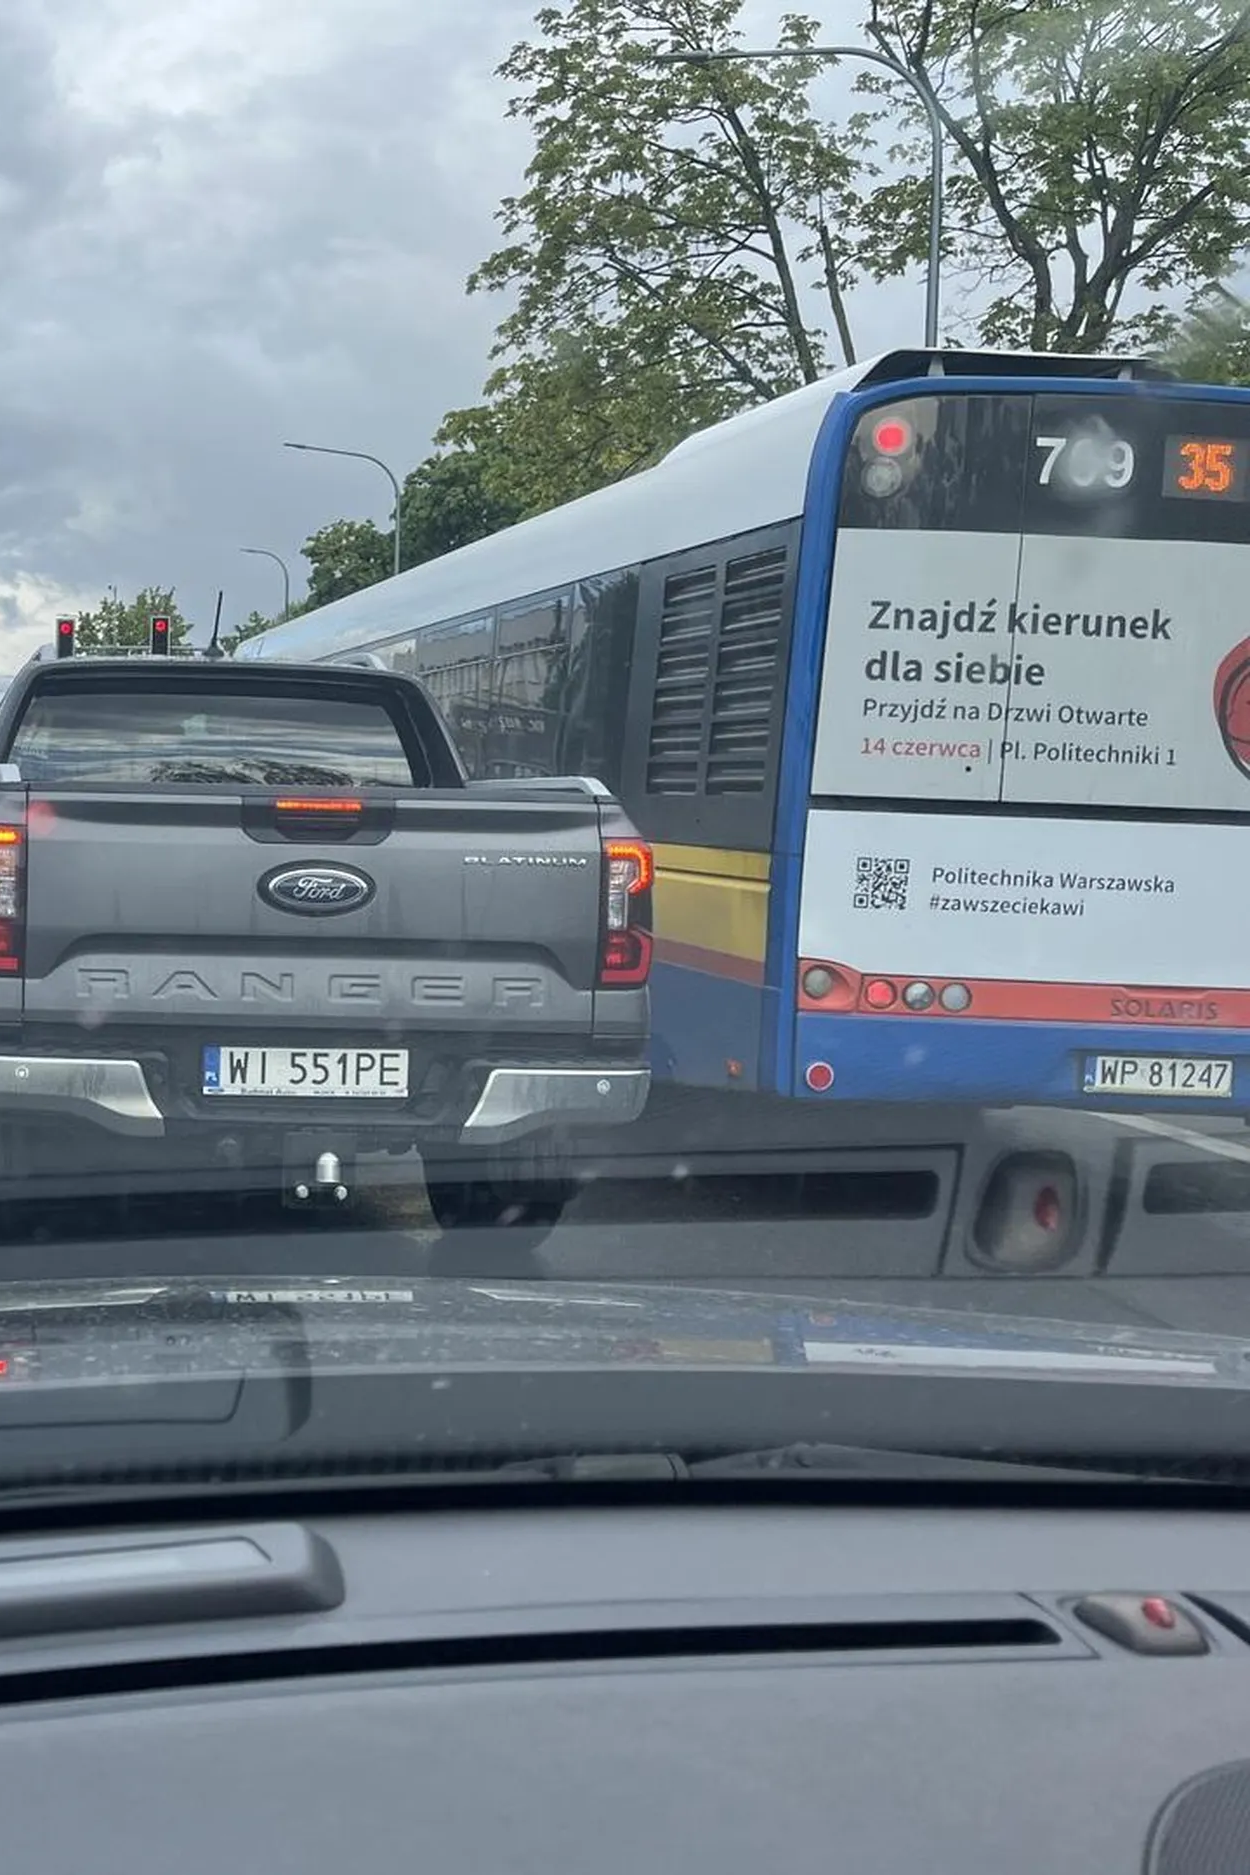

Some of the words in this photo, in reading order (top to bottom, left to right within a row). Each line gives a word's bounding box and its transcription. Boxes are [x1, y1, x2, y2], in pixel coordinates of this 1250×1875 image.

[1178, 443, 1234, 491] 35
[868, 598, 997, 640] Znajdź
[1007, 602, 1172, 640] kierunek
[865, 651, 923, 682] dla
[934, 652, 1046, 686] siebie
[862, 698, 947, 723] Przyjdź
[953, 704, 980, 720] na
[987, 702, 1051, 723] Drzwi
[1058, 705, 1149, 727] Otwarte
[860, 737, 886, 755] 14
[892, 740, 981, 758] czerwca
[1000, 741, 1027, 760] Pl.
[1034, 742, 1160, 765] Politechniki
[1165, 749, 1177, 766] 1
[463, 855, 588, 868] PLATINUM
[292, 876, 347, 899] Ford
[932, 867, 1054, 888] Politechnika
[1060, 873, 1175, 893] Warszawska
[929, 895, 1085, 917] #zawszeciekawi
[76, 967, 547, 1008] RANGER
[1110, 998, 1218, 1020] SOLARIS
[229, 1051, 267, 1085] WI
[289, 1051, 401, 1086] 551PE
[1100, 1058, 1139, 1085] WP
[1149, 1060, 1228, 1090] 81247
